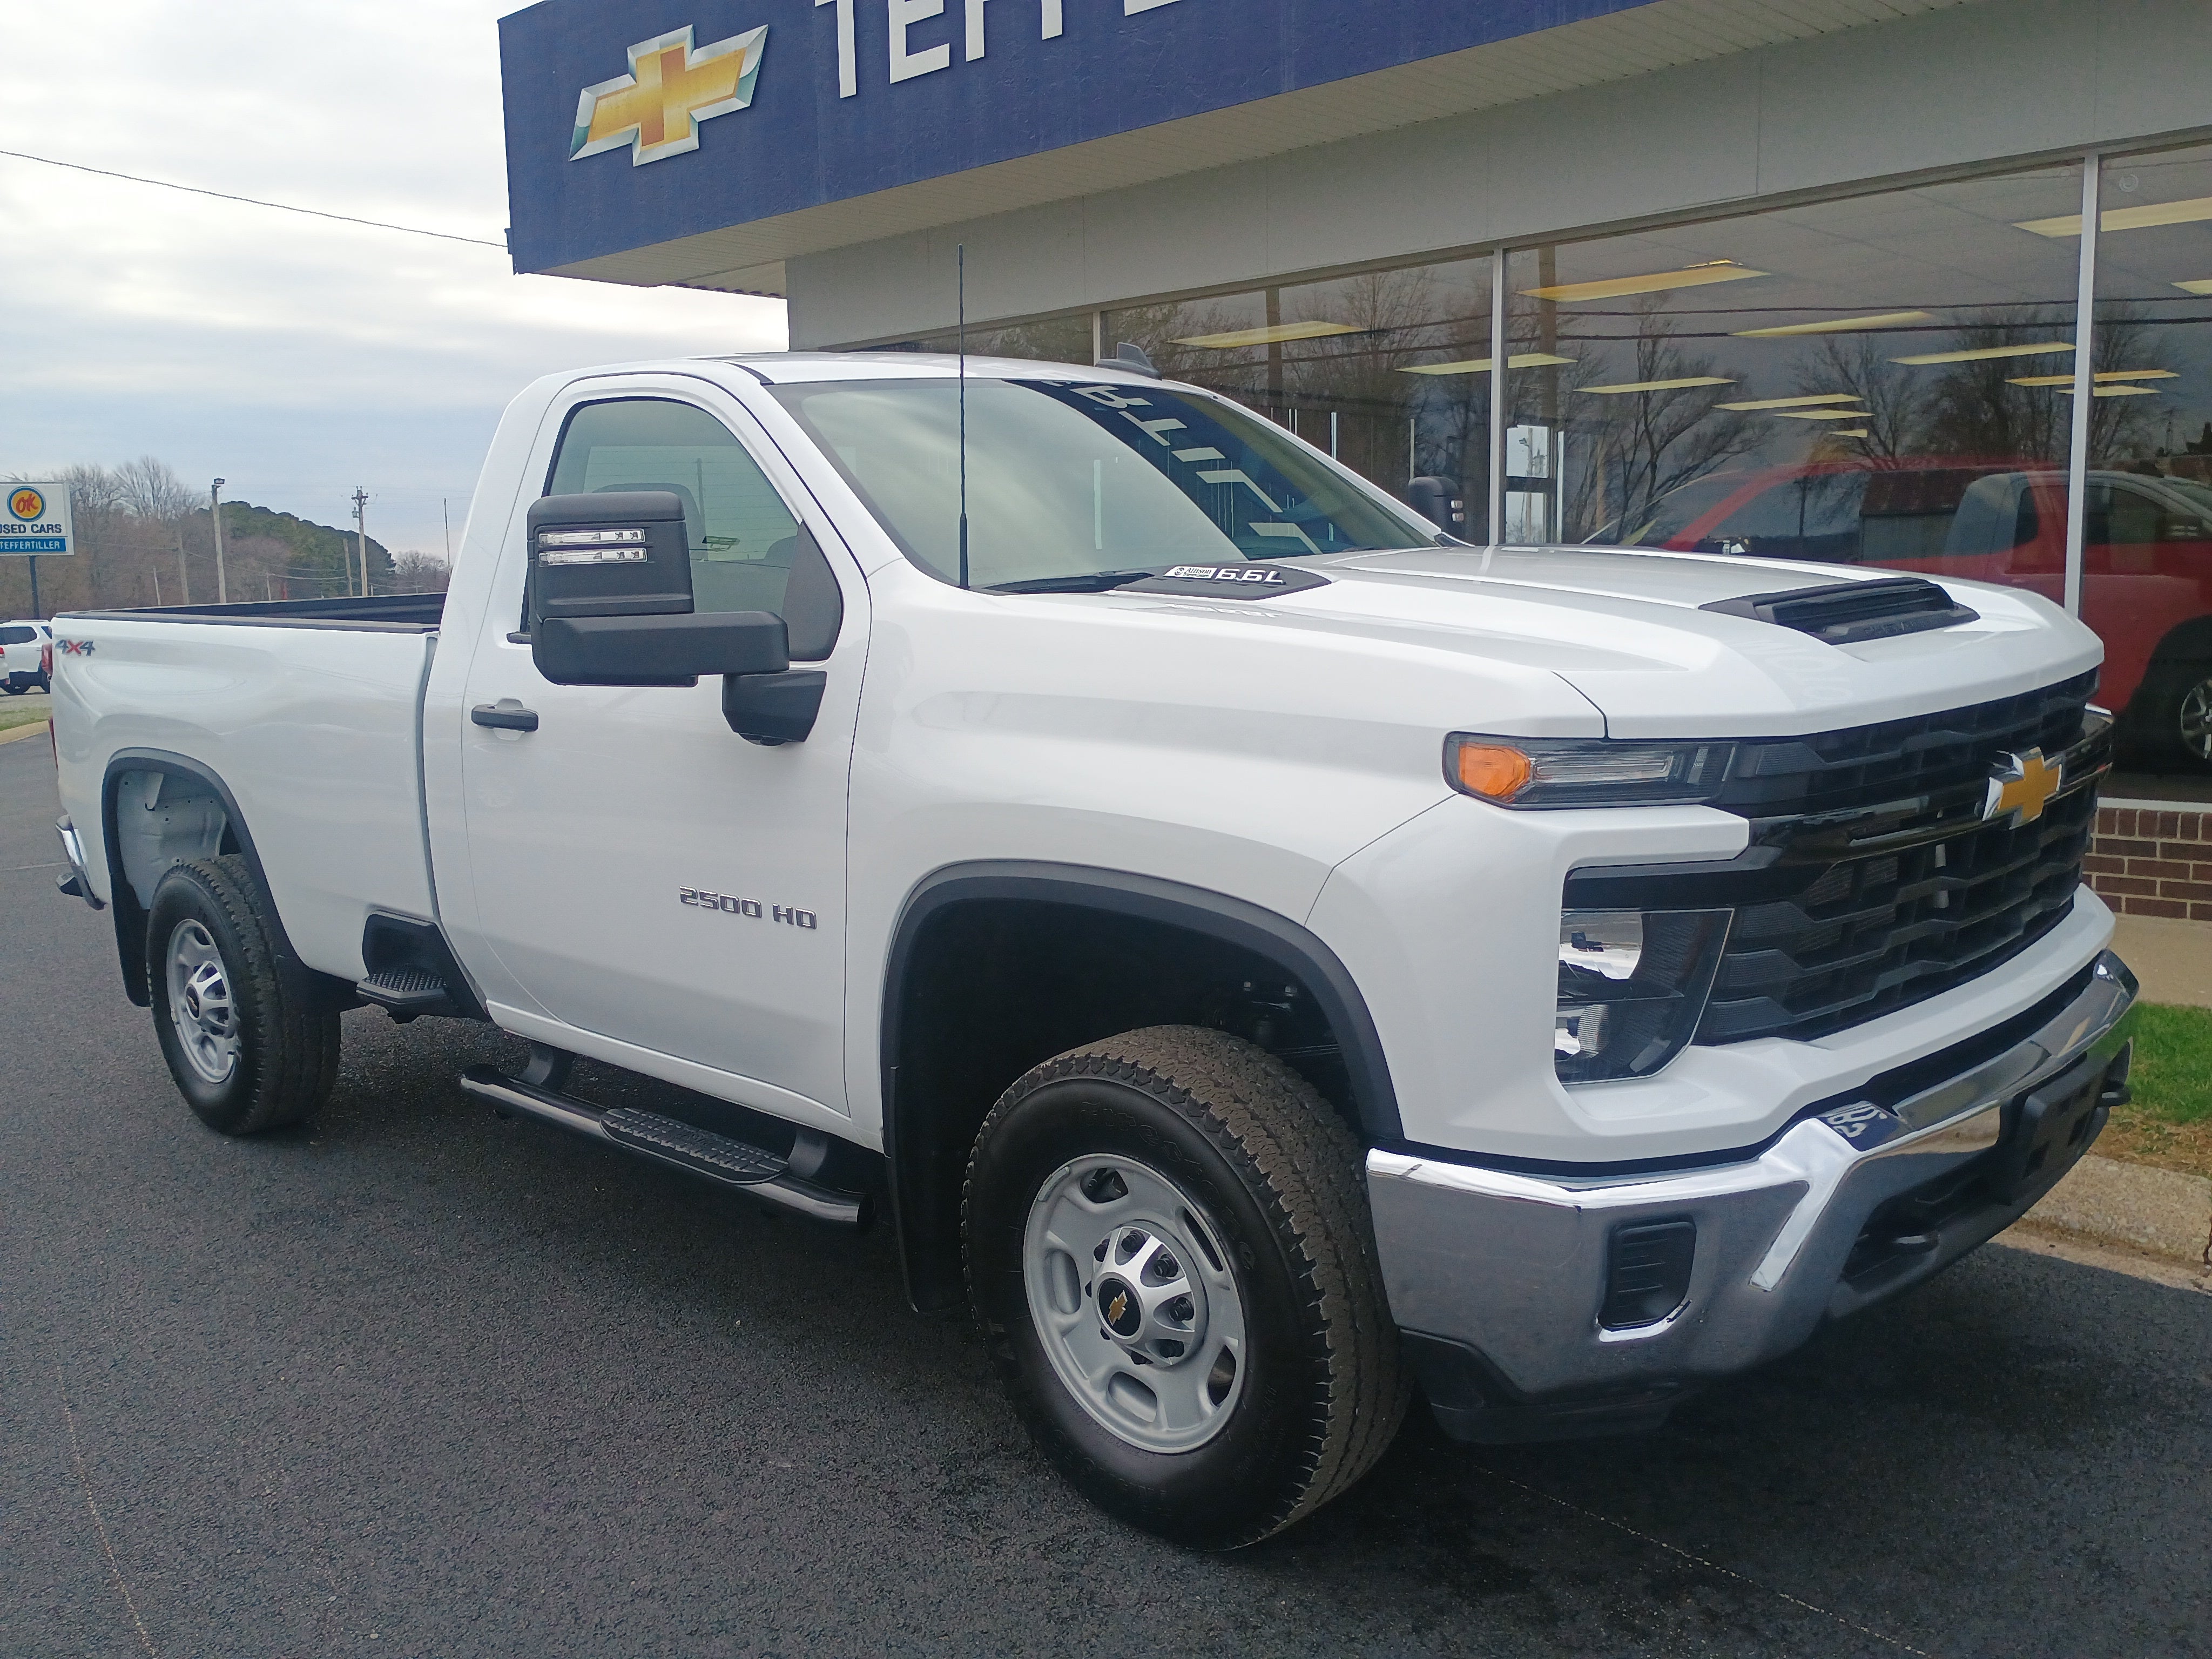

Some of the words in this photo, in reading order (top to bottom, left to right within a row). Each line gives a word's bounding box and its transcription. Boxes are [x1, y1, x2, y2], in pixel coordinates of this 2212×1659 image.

[16, 493, 38, 513] OK
[31, 524, 62, 534] CARS
[1215, 568, 1286, 584] 6.6L
[679, 886, 763, 918] 2500
[772, 903, 817, 929] HD
